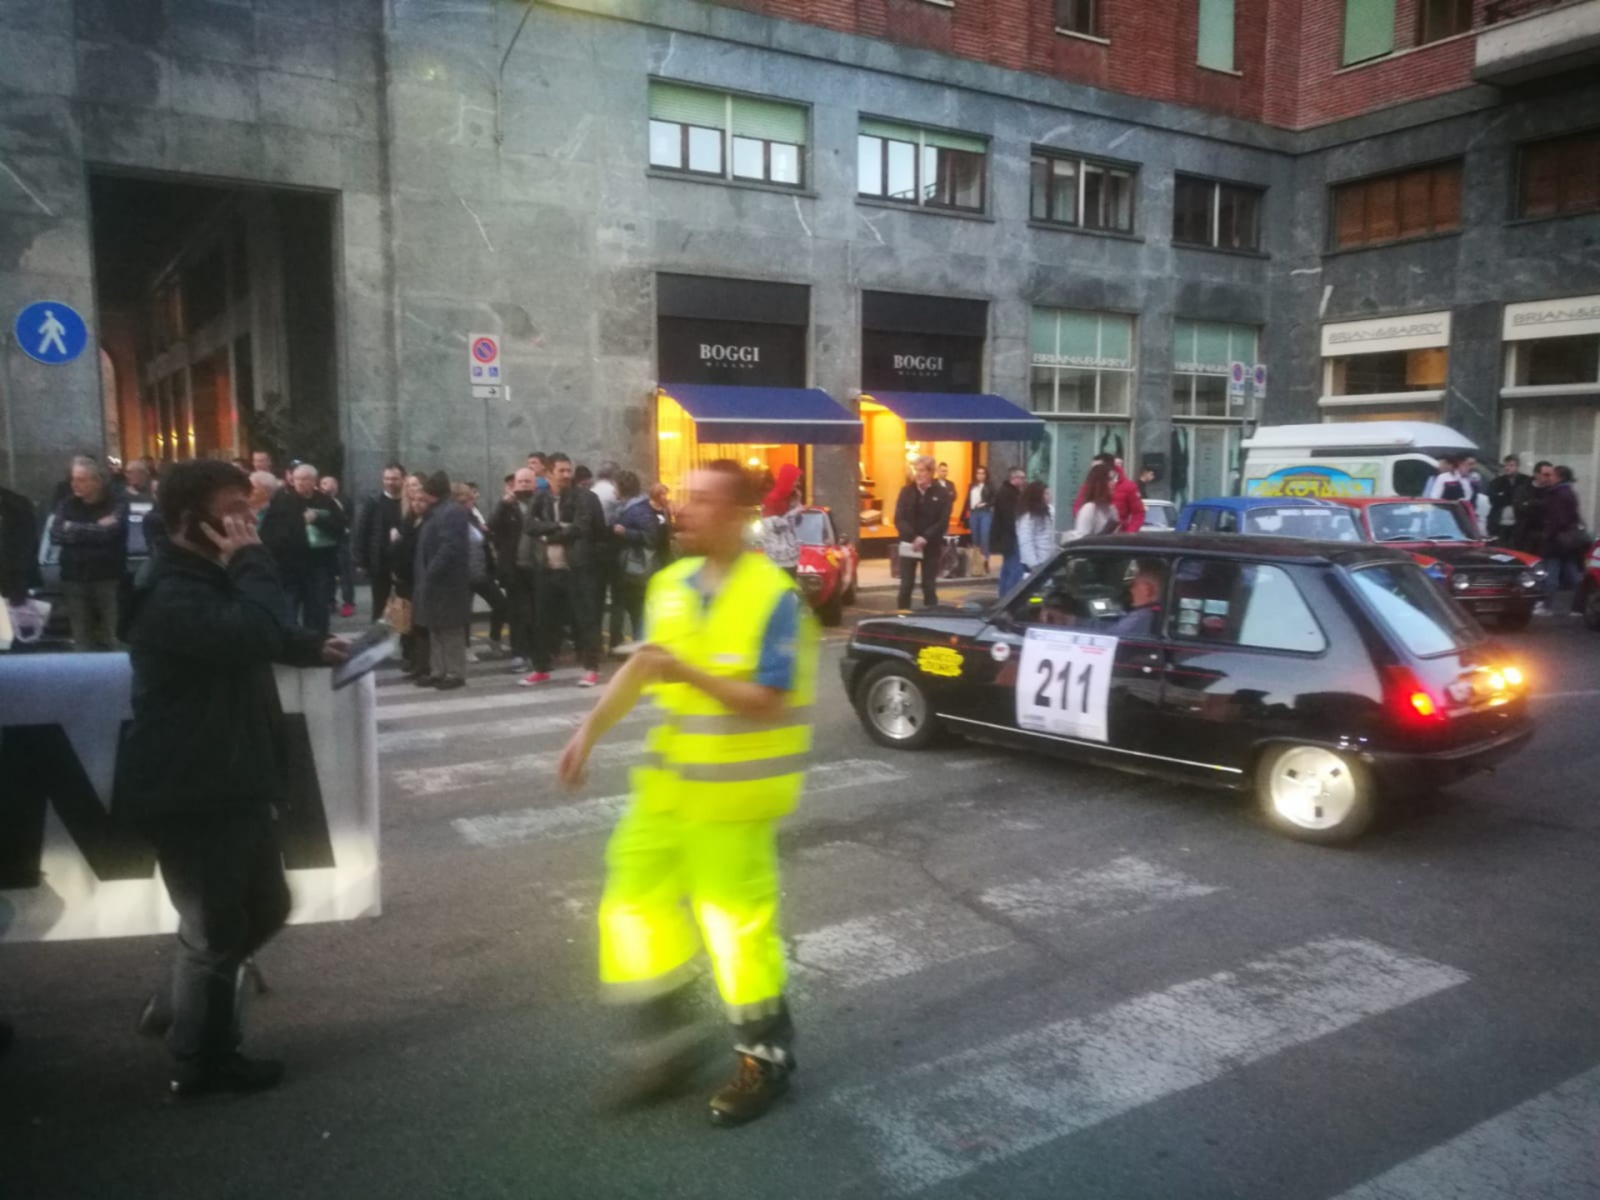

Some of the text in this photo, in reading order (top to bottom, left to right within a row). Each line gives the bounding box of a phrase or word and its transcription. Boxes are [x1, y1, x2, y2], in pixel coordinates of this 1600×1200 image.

[700, 344, 760, 362] BOGGI
[893, 354, 943, 371] BOGGI
[1034, 658, 1093, 714] 211
